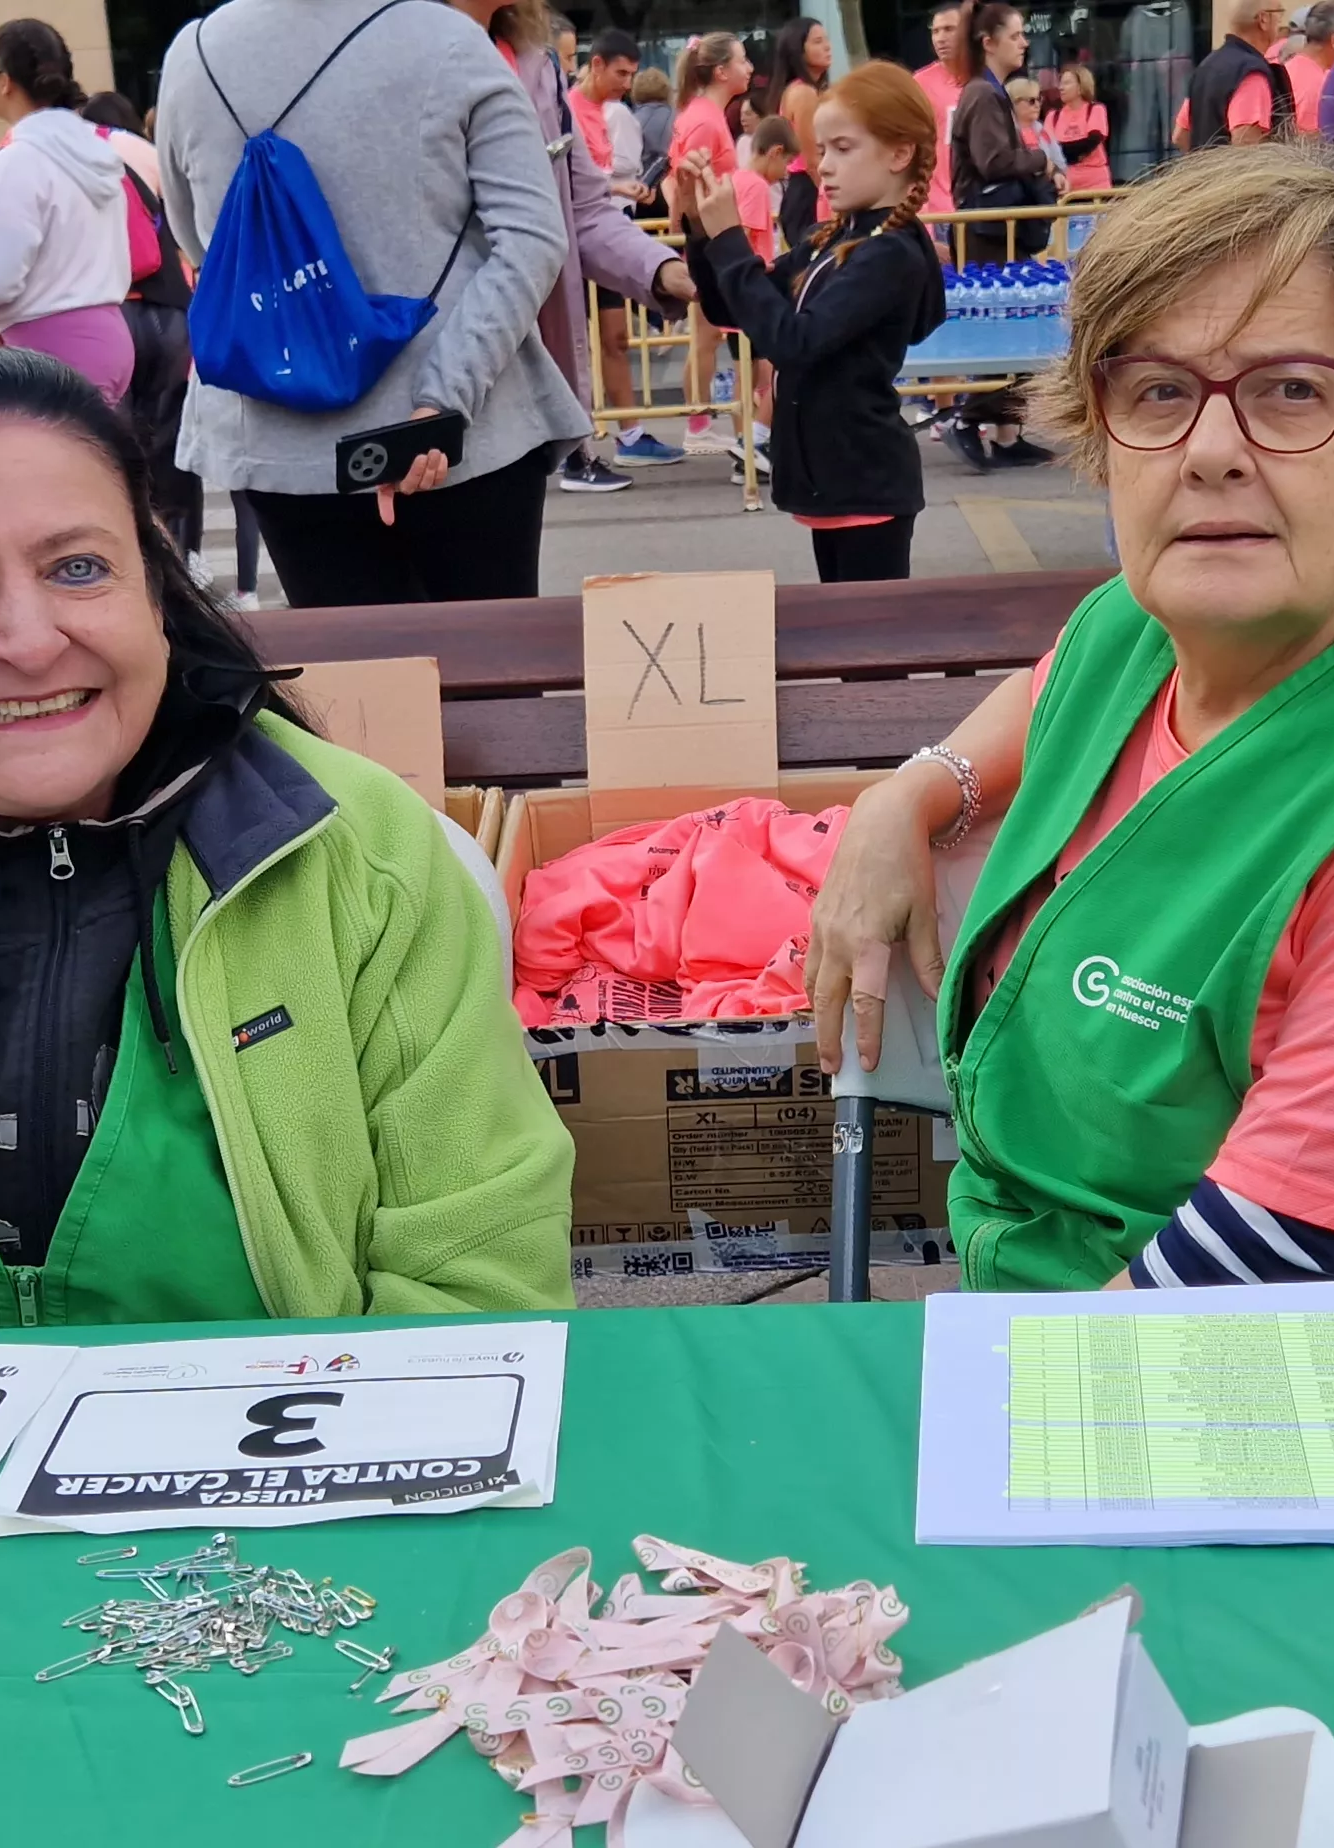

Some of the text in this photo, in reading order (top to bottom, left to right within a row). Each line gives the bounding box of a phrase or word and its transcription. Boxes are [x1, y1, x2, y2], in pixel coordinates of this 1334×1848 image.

[622, 619, 746, 720] XL
[1113, 988, 1142, 1007] contra
[1142, 999, 1156, 1012] el
[1115, 1004, 1161, 1031] Huesca
[696, 1107, 818, 1124] XL (04)
[672, 1131, 703, 1141] Order
[236, 1391, 345, 1459] 3
[55, 1458, 482, 1497] CONTRA EL CÁNCER
[403, 1474, 507, 1503] XI EDICIÓN
[198, 1487, 327, 1505] HUESCA
